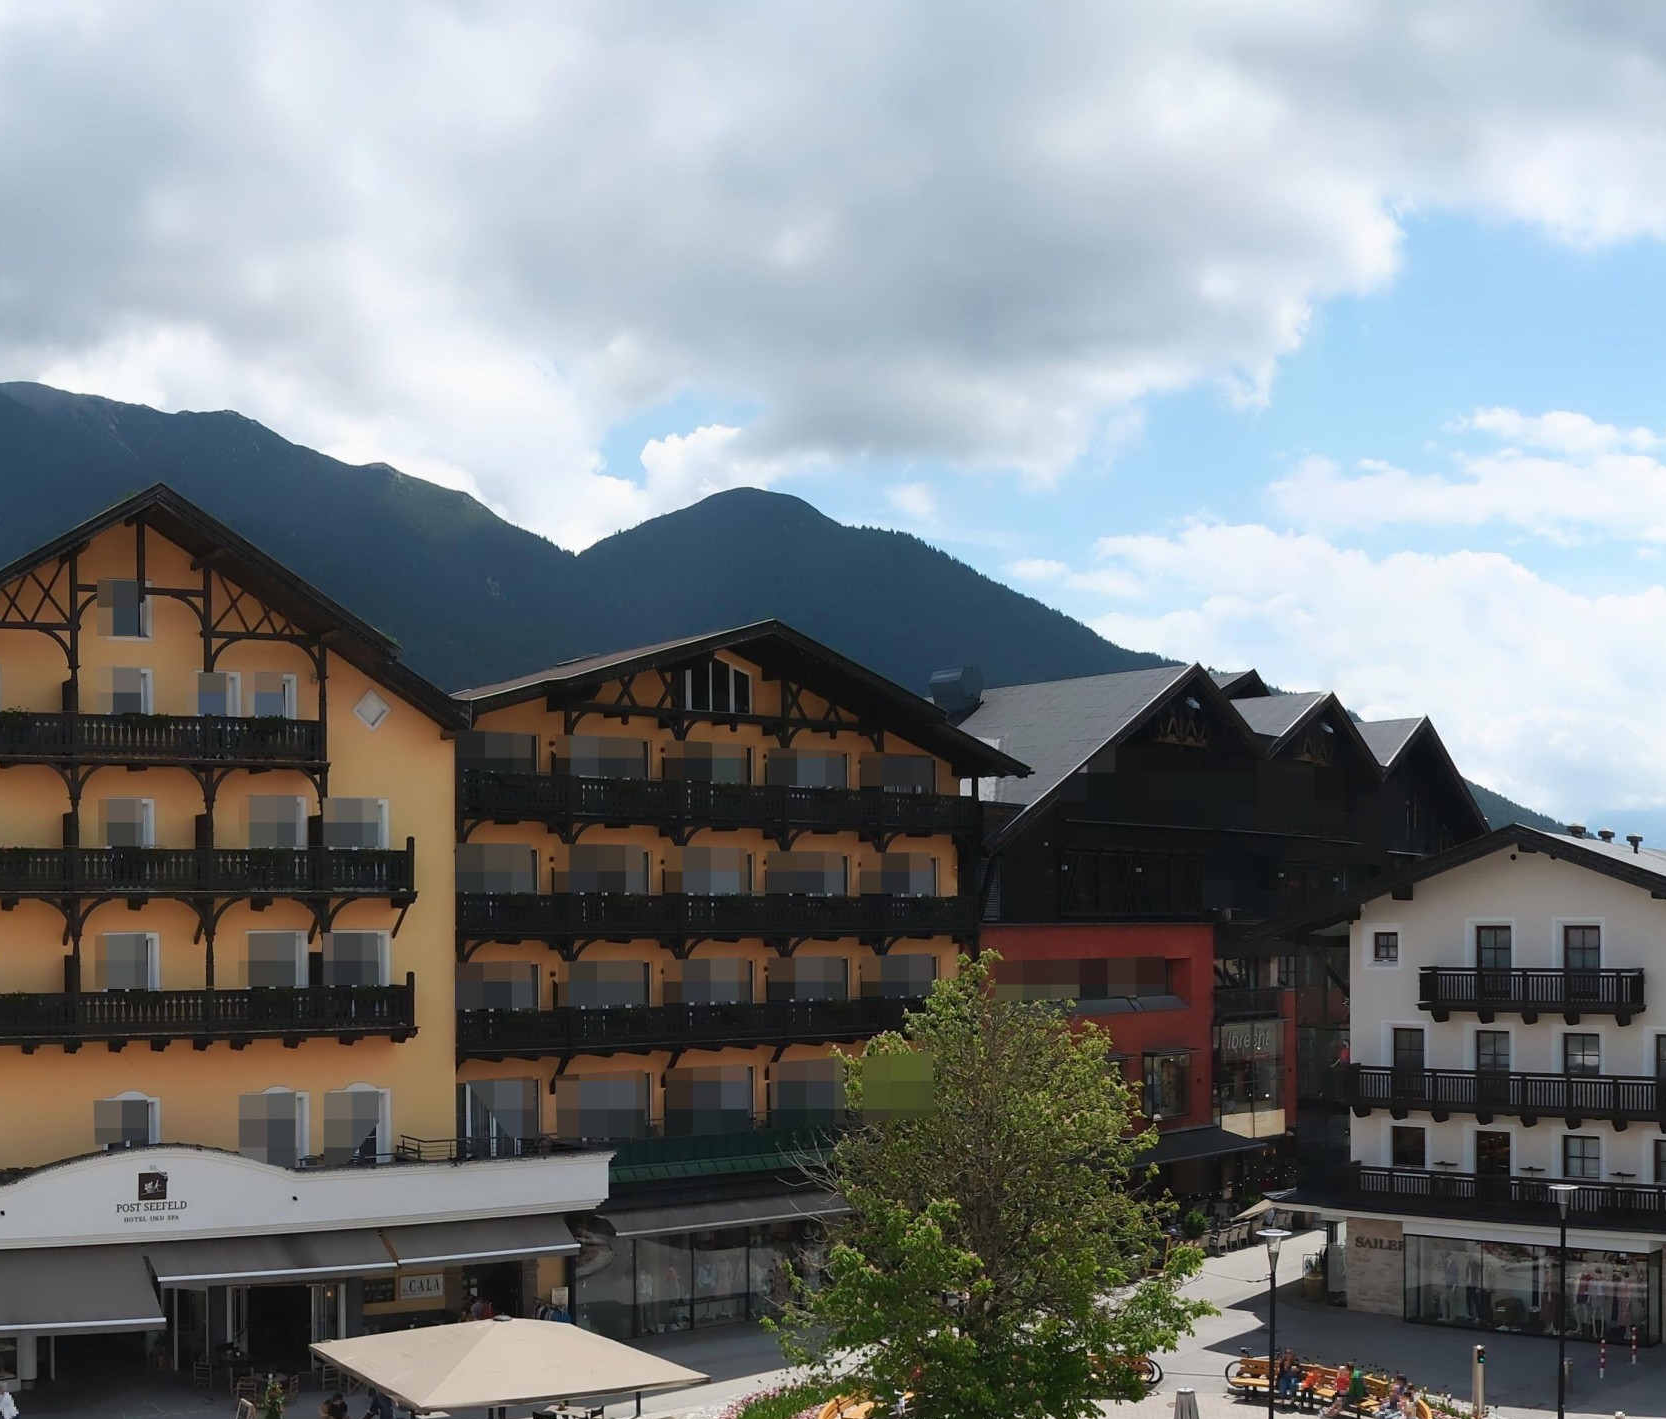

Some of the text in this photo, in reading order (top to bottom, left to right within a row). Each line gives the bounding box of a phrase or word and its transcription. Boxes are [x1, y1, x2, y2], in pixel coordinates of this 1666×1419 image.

[116, 1200, 188, 1213] POST SEEFELD
[409, 1278, 440, 1293] CALA
